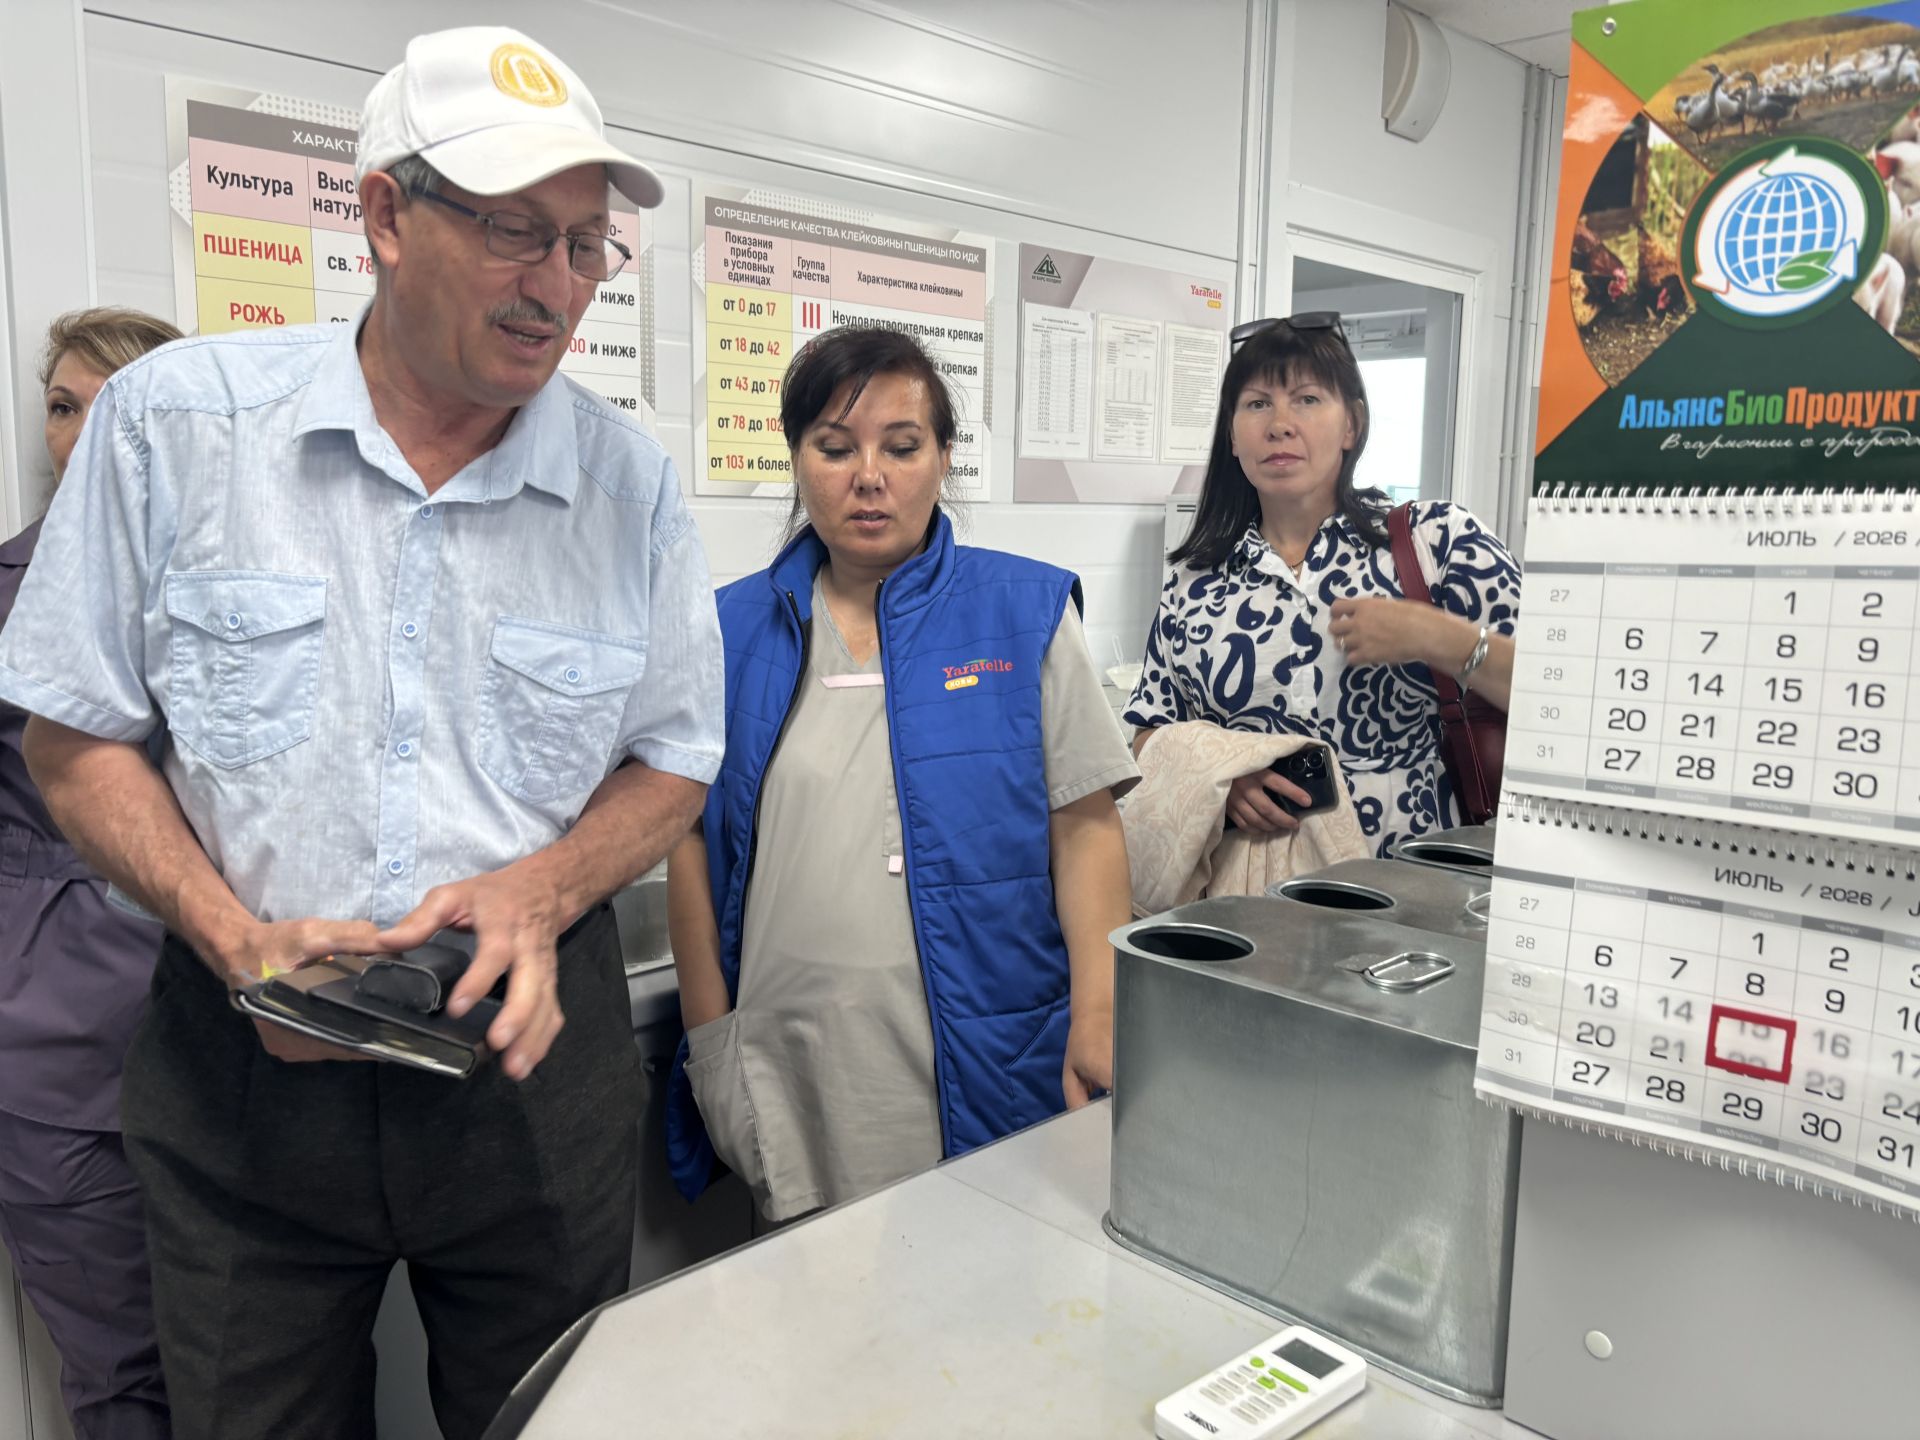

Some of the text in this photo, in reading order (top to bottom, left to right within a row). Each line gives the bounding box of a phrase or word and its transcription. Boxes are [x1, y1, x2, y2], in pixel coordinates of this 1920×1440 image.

[206, 164, 293, 197] Культура
[317, 171, 360, 194] Выс
[714, 206, 979, 264] ОПРЕДЕЛЕНИЕ КАЧЕСТВА КЛЕЙКОВИНЫ ПШЕНИЦЫ ПО ИДК
[725, 231, 773, 250] Показания
[203, 233, 303, 265] ПШЕНИЦА
[730, 246, 768, 263] прибора
[723, 258, 775, 275] в условных
[797, 256, 825, 272] Группа
[728, 271, 771, 286] единицах
[792, 269, 830, 284] качества
[857, 271, 963, 298] Характеристика клейковины
[600, 290, 635, 307] ниже
[723, 298, 776, 317] от 0 до 17
[229, 302, 285, 325] РОЖЬ
[720, 336, 780, 356] от 18 до 42
[947, 328, 984, 343] крепкая
[590, 342, 598, 355] и
[602, 345, 637, 359] ниже
[941, 362, 978, 377] крепкая
[720, 376, 780, 394] от 43 до 77
[606, 396, 637, 411] иже
[1618, 386, 1920, 430] АльянсБиоПродукт
[717, 415, 784, 433] от 78 до 102
[710, 455, 791, 471] от 103 и более
[1746, 530, 1816, 547] ИЮЛЬ
[1853, 531, 1907, 546] 2026
[1550, 589, 1883, 618] 27 1 2
[1546, 628, 1879, 662] 28 6 7 8 9
[1543, 667, 1886, 709] 29 13 14 15 16
[1540, 707, 1881, 754] 30 20 21 22 23
[1536, 745, 1878, 799] 31 27 28 29 30
[1714, 866, 1784, 893] ИЮЛЬ
[1819, 886, 1872, 907] 2026
[1519, 896, 1540, 912] 27
[1751, 931, 1765, 955] 1
[1829, 946, 1850, 972] 2
[1515, 935, 1536, 950] 28
[1594, 944, 1614, 968] 6
[1669, 956, 1688, 979] 7
[1745, 972, 1765, 996] 8
[1824, 989, 1845, 1013] 9
[1511, 972, 1531, 988] 29
[1583, 983, 1619, 1009] 13
[1656, 996, 1694, 1024] 14
[1812, 1028, 1852, 1060] 16
[1507, 1010, 1528, 1026] 30
[1576, 1021, 1616, 1049] 20
[1649, 1033, 1686, 1063] 21
[1804, 1070, 1847, 1101] 23
[1504, 1048, 1915, 1168] 31 27 28 29 30 31
